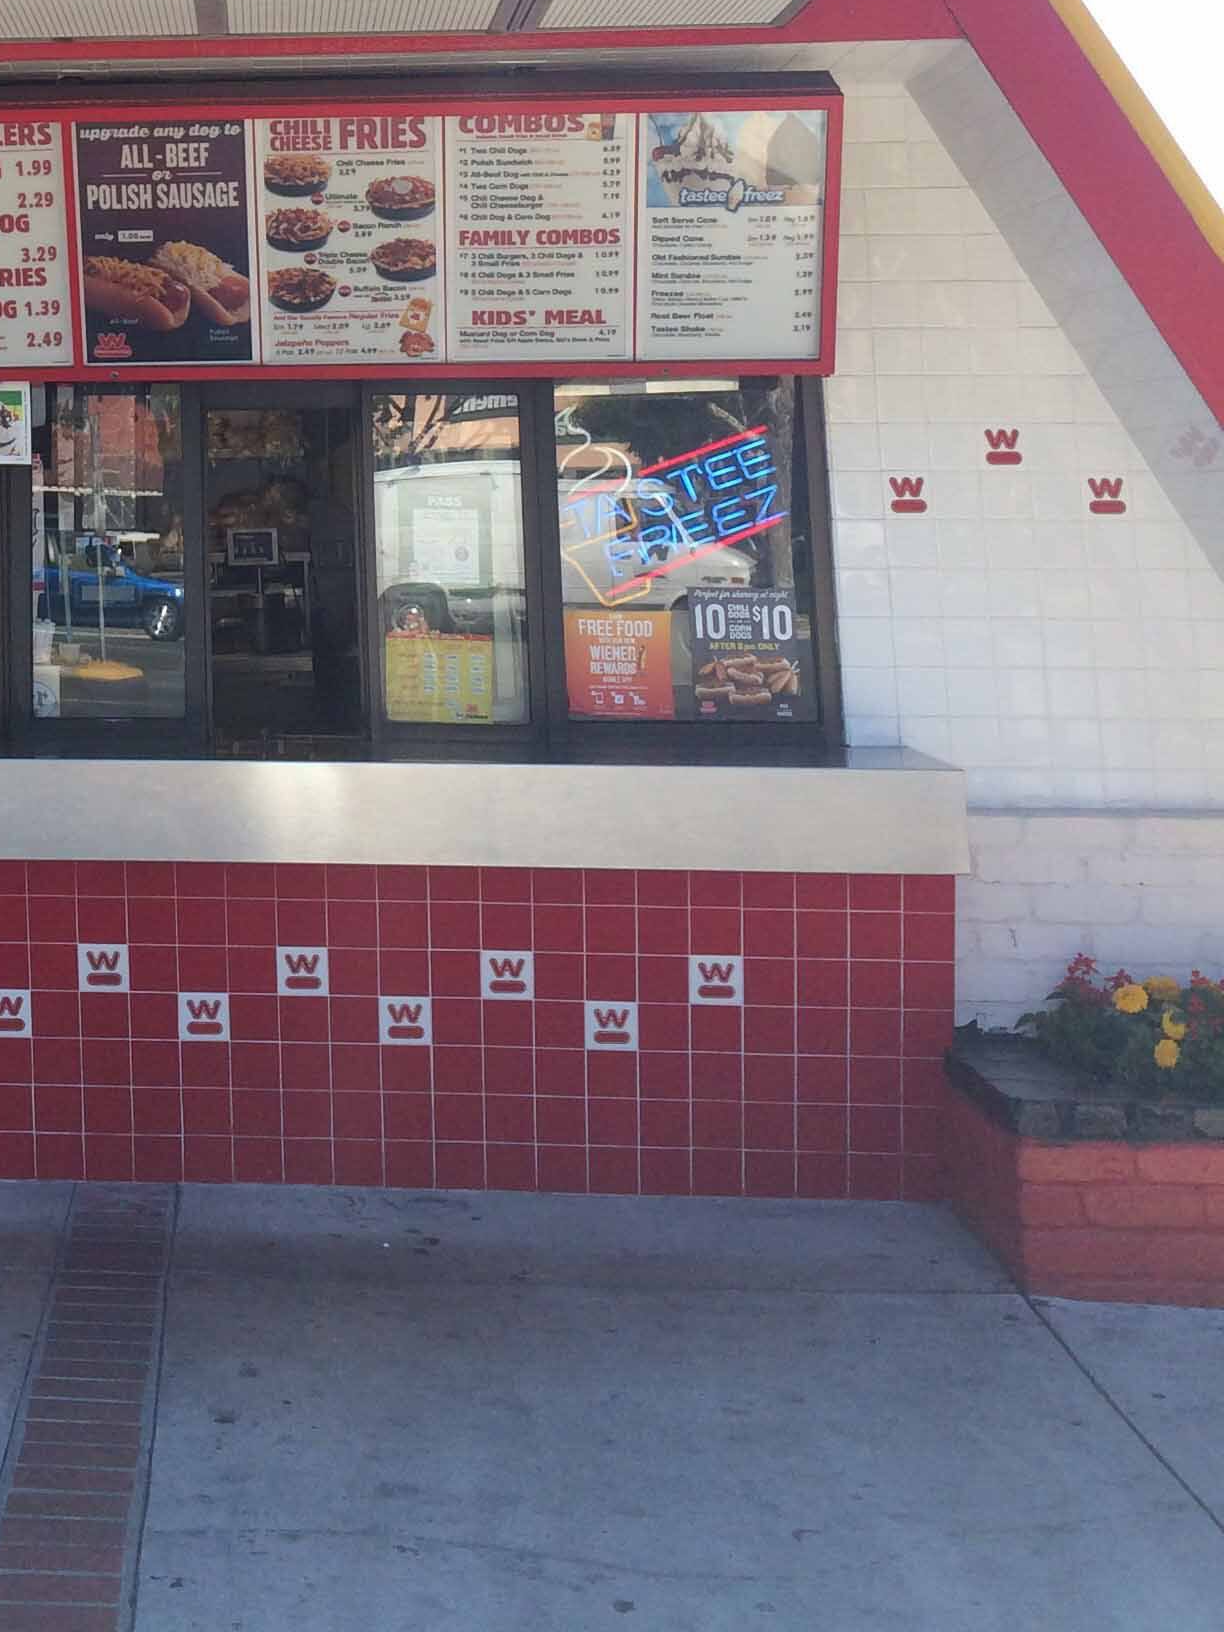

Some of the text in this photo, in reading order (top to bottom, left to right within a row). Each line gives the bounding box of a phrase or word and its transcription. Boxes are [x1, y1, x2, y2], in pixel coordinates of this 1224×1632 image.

[80, 123, 241, 140] upgrade any dog to
[270, 118, 426, 149] CHILI FRIES
[459, 115, 584, 133] COMBOS
[270, 136, 332, 151] CHEESE
[16, 160, 52, 176] 1.99
[152, 170, 174, 180] or
[17, 192, 54, 207] 2.29
[87, 182, 239, 209] POLISH SAUSAGE
[680, 189, 784, 203] tastee freez
[459, 229, 620, 245] FAMILY COMBOS
[21, 247, 57, 262] 3.29
[25, 300, 60, 316] 1.39
[472, 310, 606, 325] KIDS' MEAL
[27, 332, 62, 347] 2.49
[984, 429, 1019, 449] W
[564, 438, 776, 538] TASTEE
[889, 477, 924, 497] W
[1088, 478, 1123, 498] W
[605, 484, 790, 577] FREEZ
[728, 604, 749, 612] CHILI
[579, 620, 652, 637] FREE FOOD
[695, 604, 792, 640] 10 $10
[86, 950, 120, 970] W
[284, 953, 320, 974] W
[488, 957, 525, 977] W
[698, 962, 734, 983] W
[186, 999, 221, 1020] W
[387, 1002, 422, 1024] W
[594, 1008, 629, 1029] W
